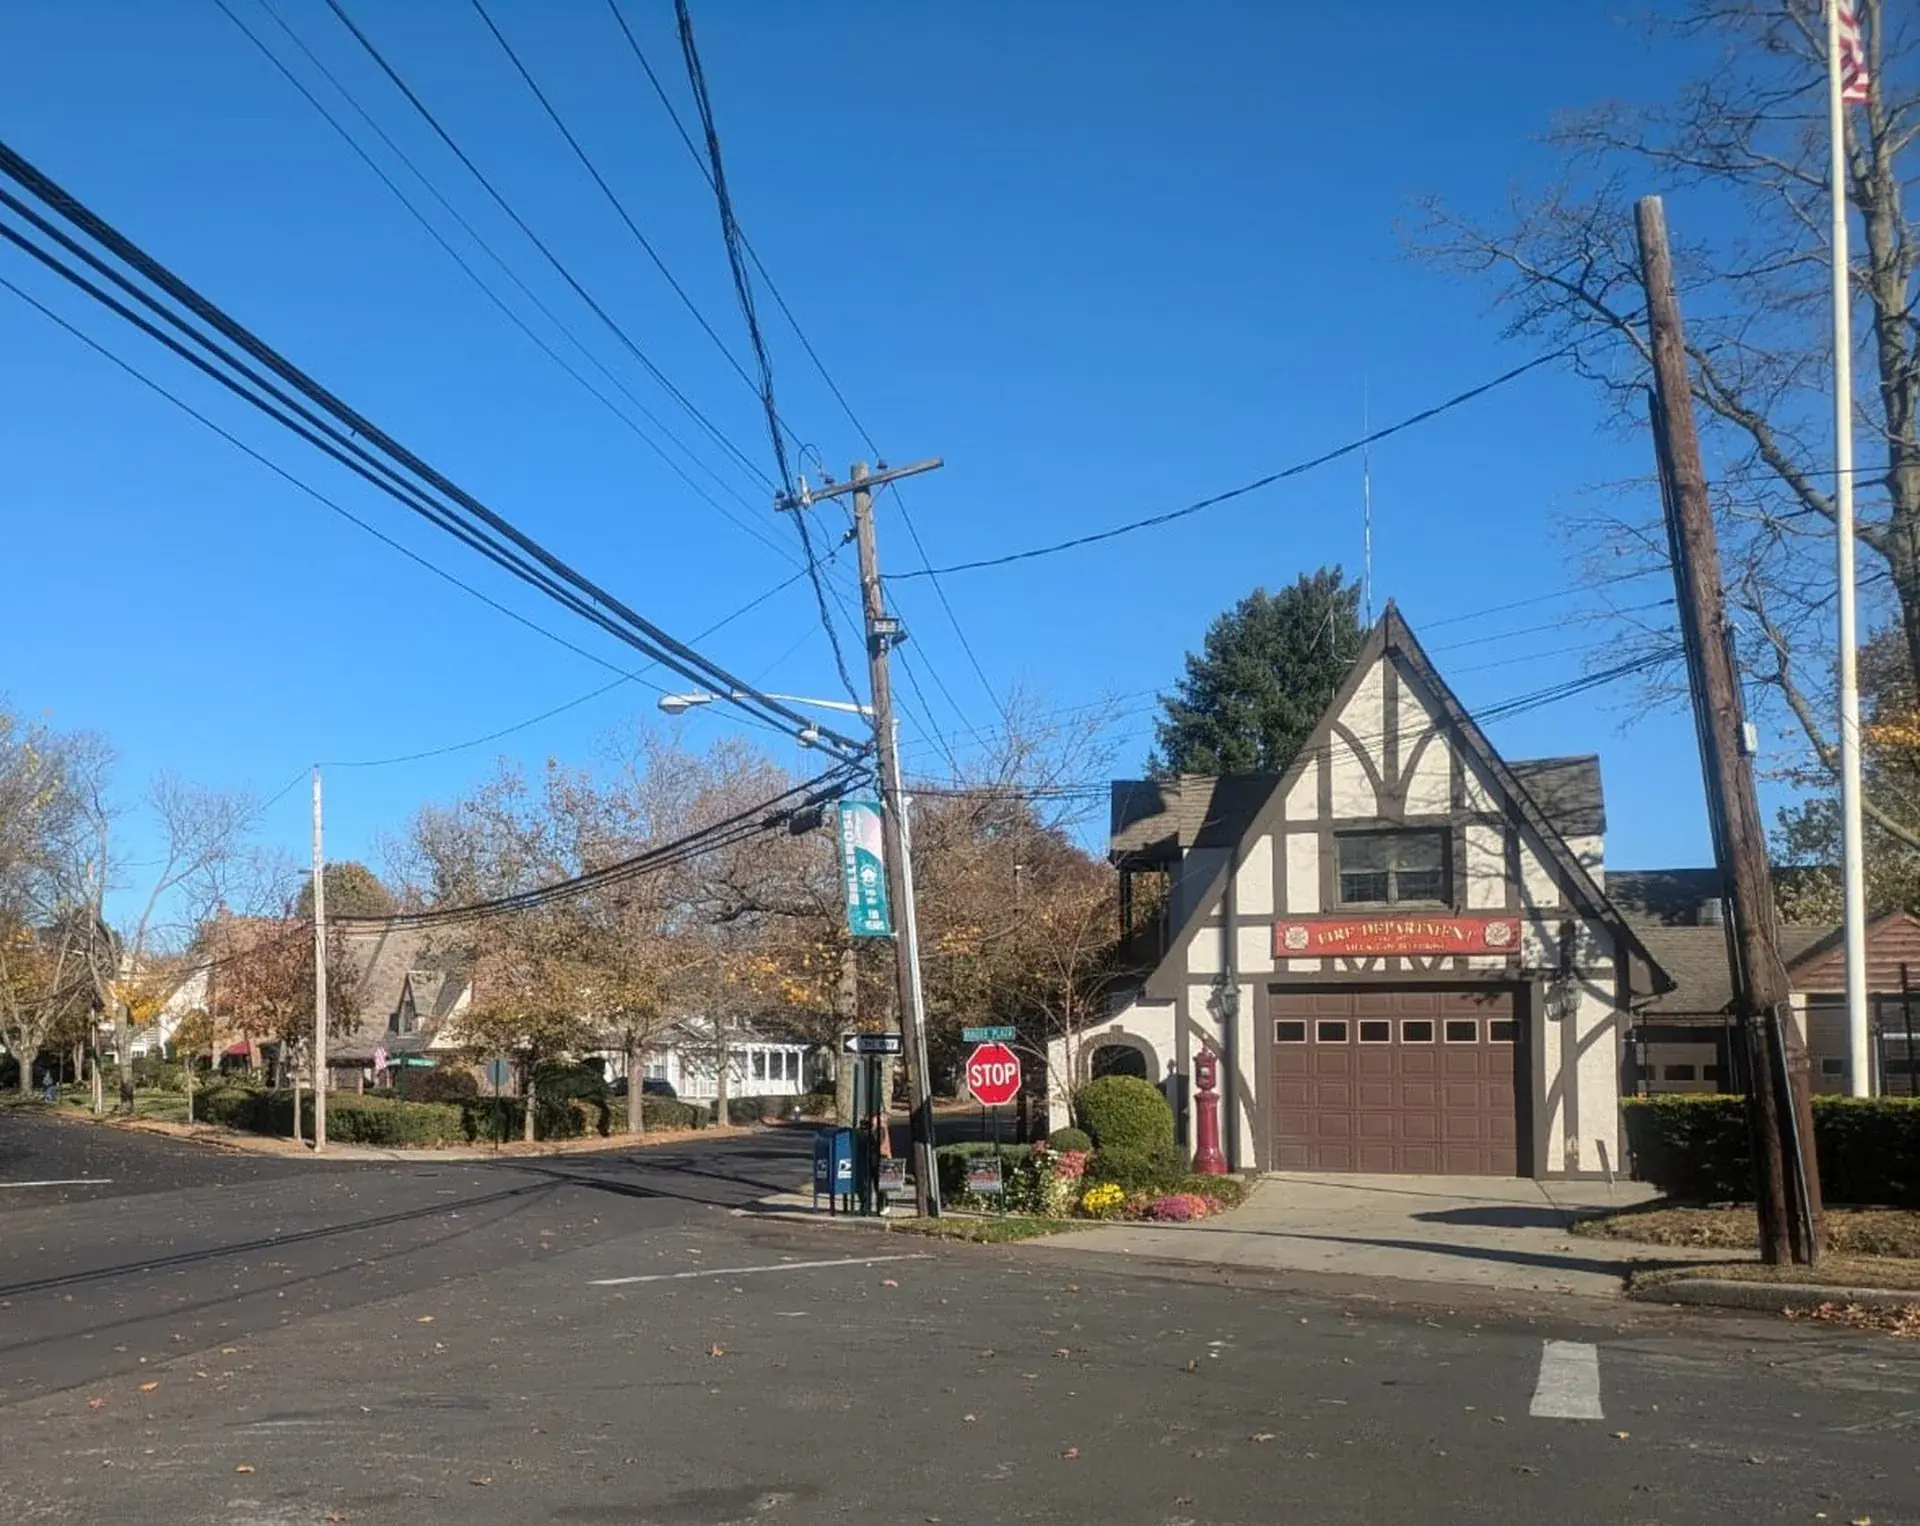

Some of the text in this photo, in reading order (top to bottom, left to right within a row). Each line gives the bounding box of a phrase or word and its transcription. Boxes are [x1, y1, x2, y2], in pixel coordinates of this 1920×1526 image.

[1317, 921, 1477, 945] FIRE DEPARTMENT
[971, 1062, 1016, 1088] STOP
